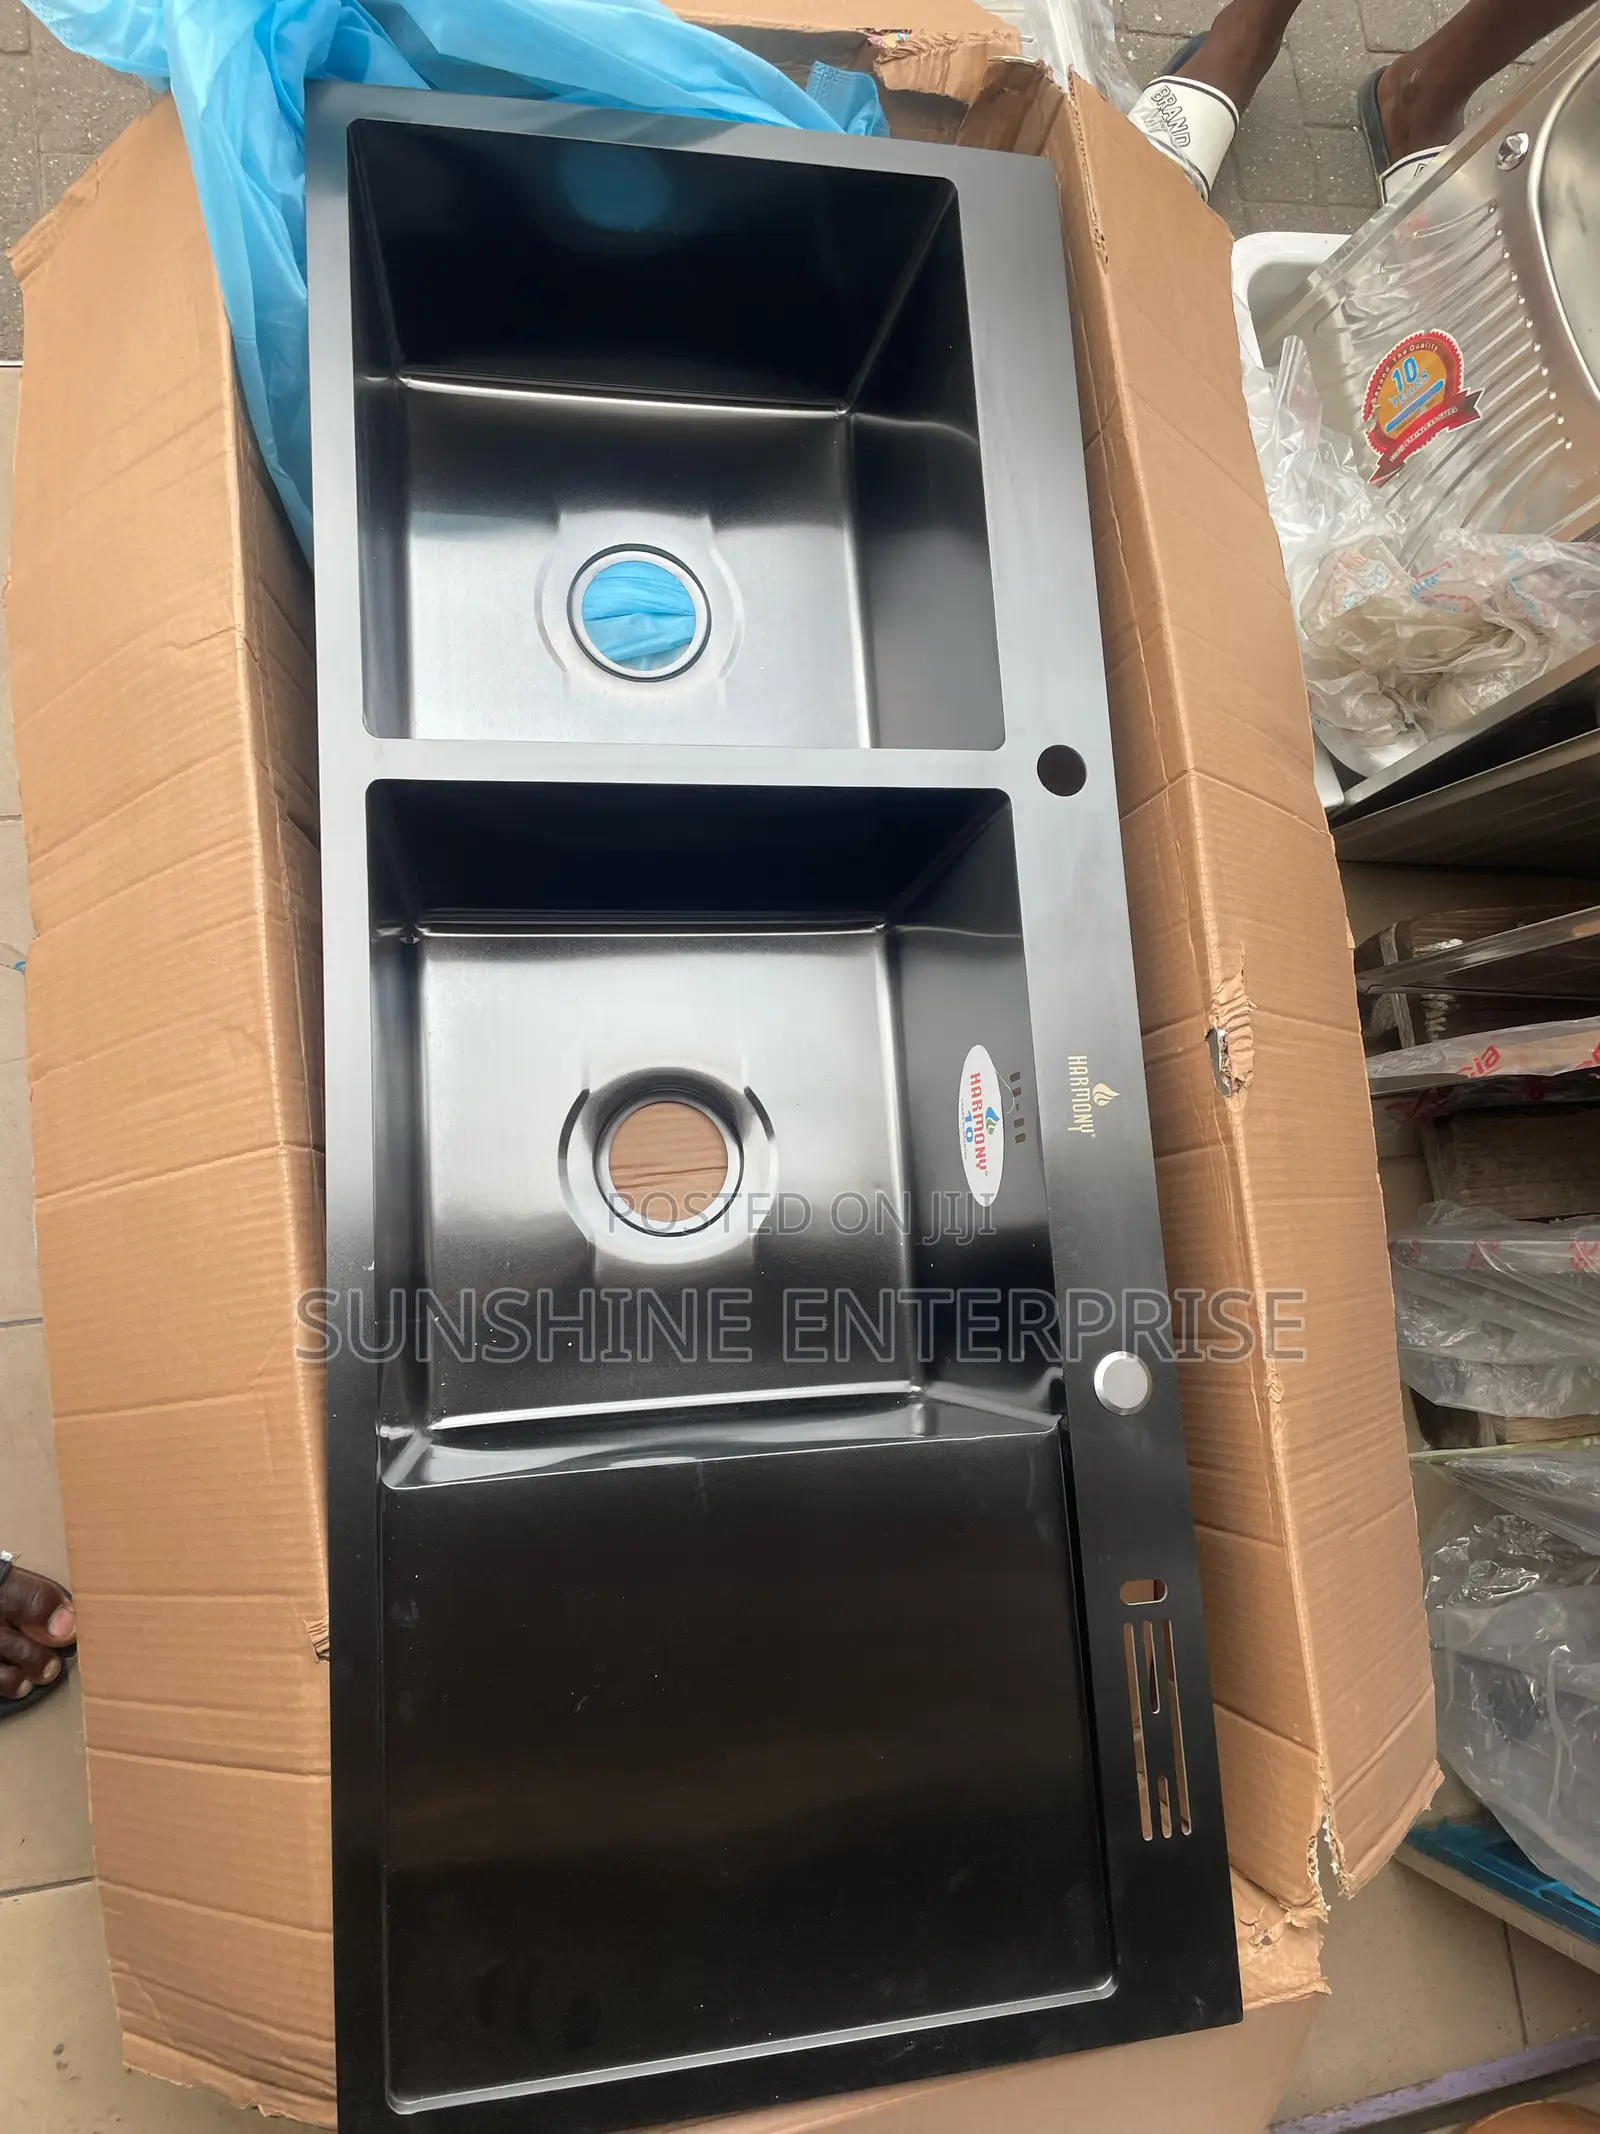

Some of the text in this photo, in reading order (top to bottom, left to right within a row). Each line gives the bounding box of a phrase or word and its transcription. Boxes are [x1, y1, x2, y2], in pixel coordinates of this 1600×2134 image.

[1150, 85, 1191, 148] BRAND
[1371, 342, 1439, 405] Beyond The Quality
[1388, 370, 1430, 408] YEARS
[1392, 356, 1419, 393] 10
[970, 1072, 987, 1172] HARMONY
[1067, 1055, 1095, 1134] HARMONY
[965, 1110, 974, 1143] 10
